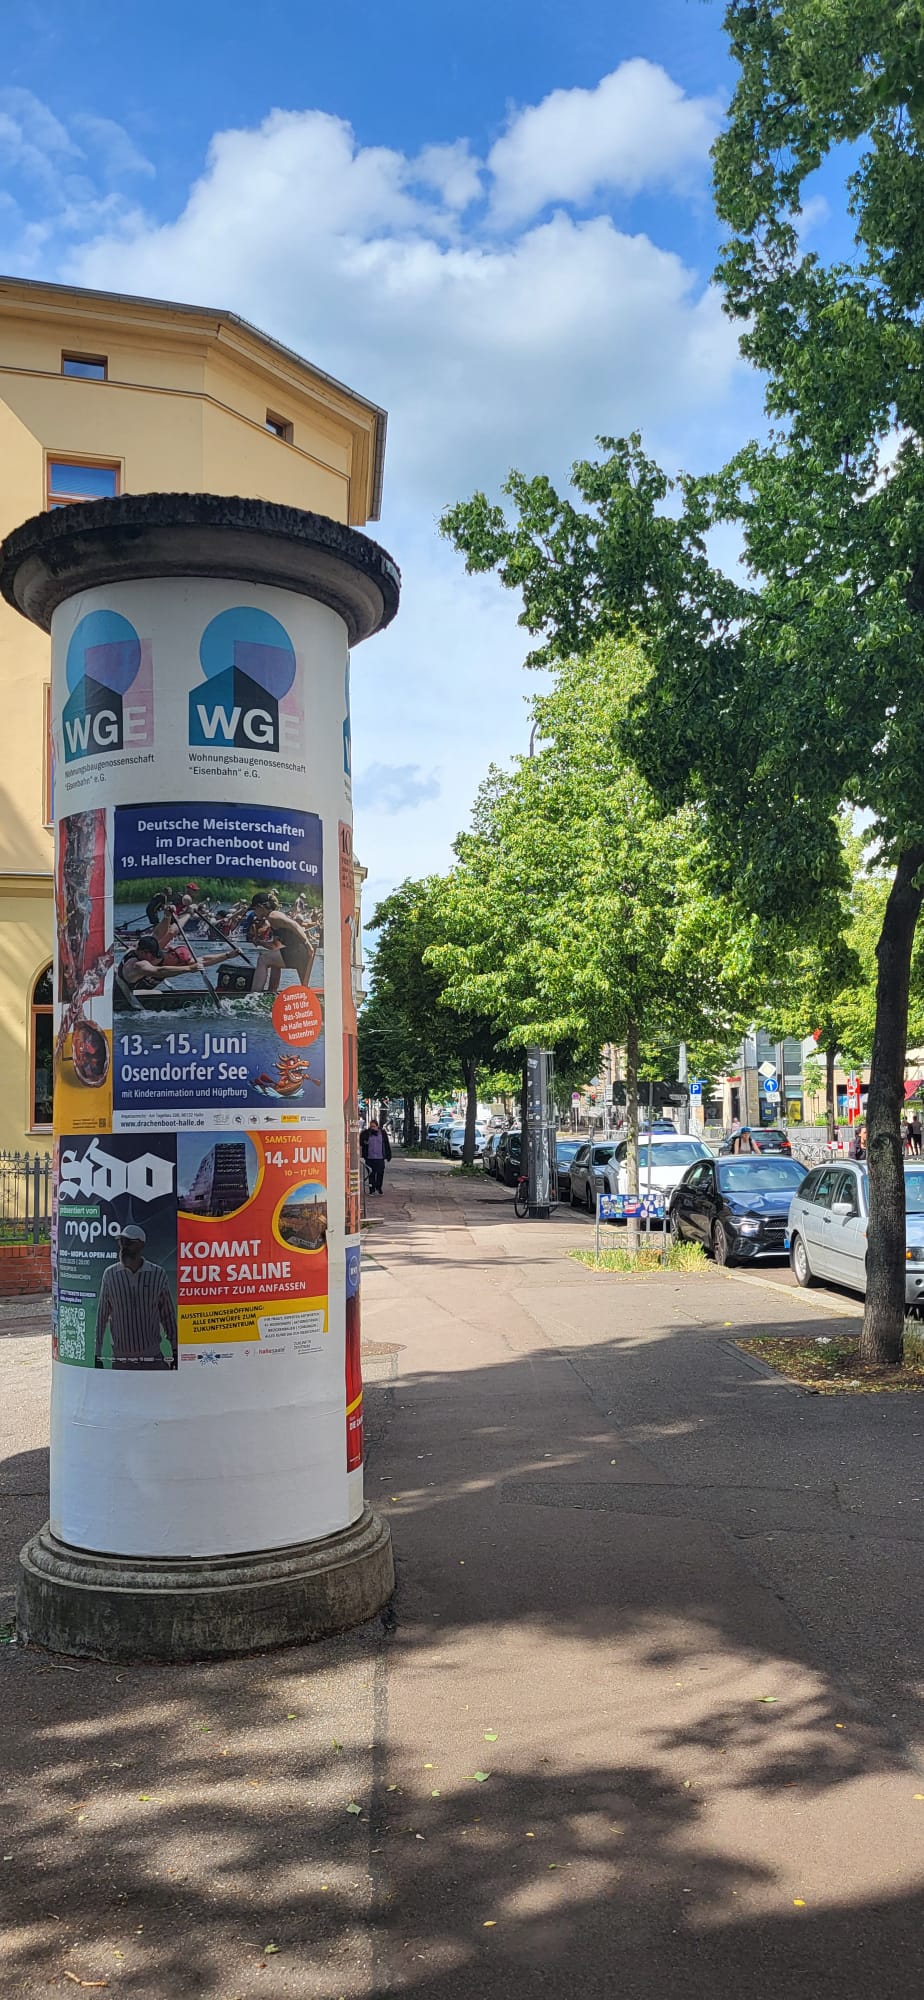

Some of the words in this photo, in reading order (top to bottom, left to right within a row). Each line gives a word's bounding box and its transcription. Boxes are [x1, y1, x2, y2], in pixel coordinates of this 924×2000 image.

[64, 705, 147, 754] WGE
[196, 704, 299, 750] WGE
[188, 753, 306, 774] Wohnungsbaugenossenschaft
[243, 769, 261, 779] e.G.
[137, 818, 199, 832] Deutsche
[202, 818, 305, 838] Meisterschaften
[155, 835, 173, 848] im
[176, 836, 264, 850] Drachenboot
[267, 840, 290, 852] und
[120, 856, 138, 868] 19.
[141, 853, 212, 866] Hallescher
[215, 854, 297, 871] Drachenboot
[299, 859, 318, 876] Cup
[282, 992, 307, 1001] Samstag,
[201, 1032, 247, 1058] Juni
[121, 1063, 213, 1082] Osendorfer
[218, 1063, 248, 1079] See
[121, 1088, 132, 1098] mit
[134, 1088, 194, 1098] Kinderanimation
[196, 1088, 210, 1097] und
[212, 1087, 248, 1099] Hüpfburg
[120, 1118, 205, 1127] www.drachenboot-halle.de
[265, 1135, 302, 1144] SAMSTAG
[265, 1150, 289, 1168] 14.
[292, 1146, 326, 1165] JUNI
[308, 1168, 320, 1176] Uhr
[65, 1214, 121, 1243] mopla
[180, 1239, 261, 1259] KOMMT
[180, 1264, 221, 1283] ZUR
[226, 1261, 291, 1281] SALINE
[179, 1286, 229, 1297] ZUKUNFT
[232, 1284, 256, 1294] ZUM
[258, 1281, 306, 1291] ANFASSEN
[192, 1317, 206, 1325] ALLE
[207, 1314, 241, 1324] ENTWÜRFE
[242, 1313, 257, 1321] ZUM
[193, 1320, 255, 1333] ZUKUNFTSZENTRUM
